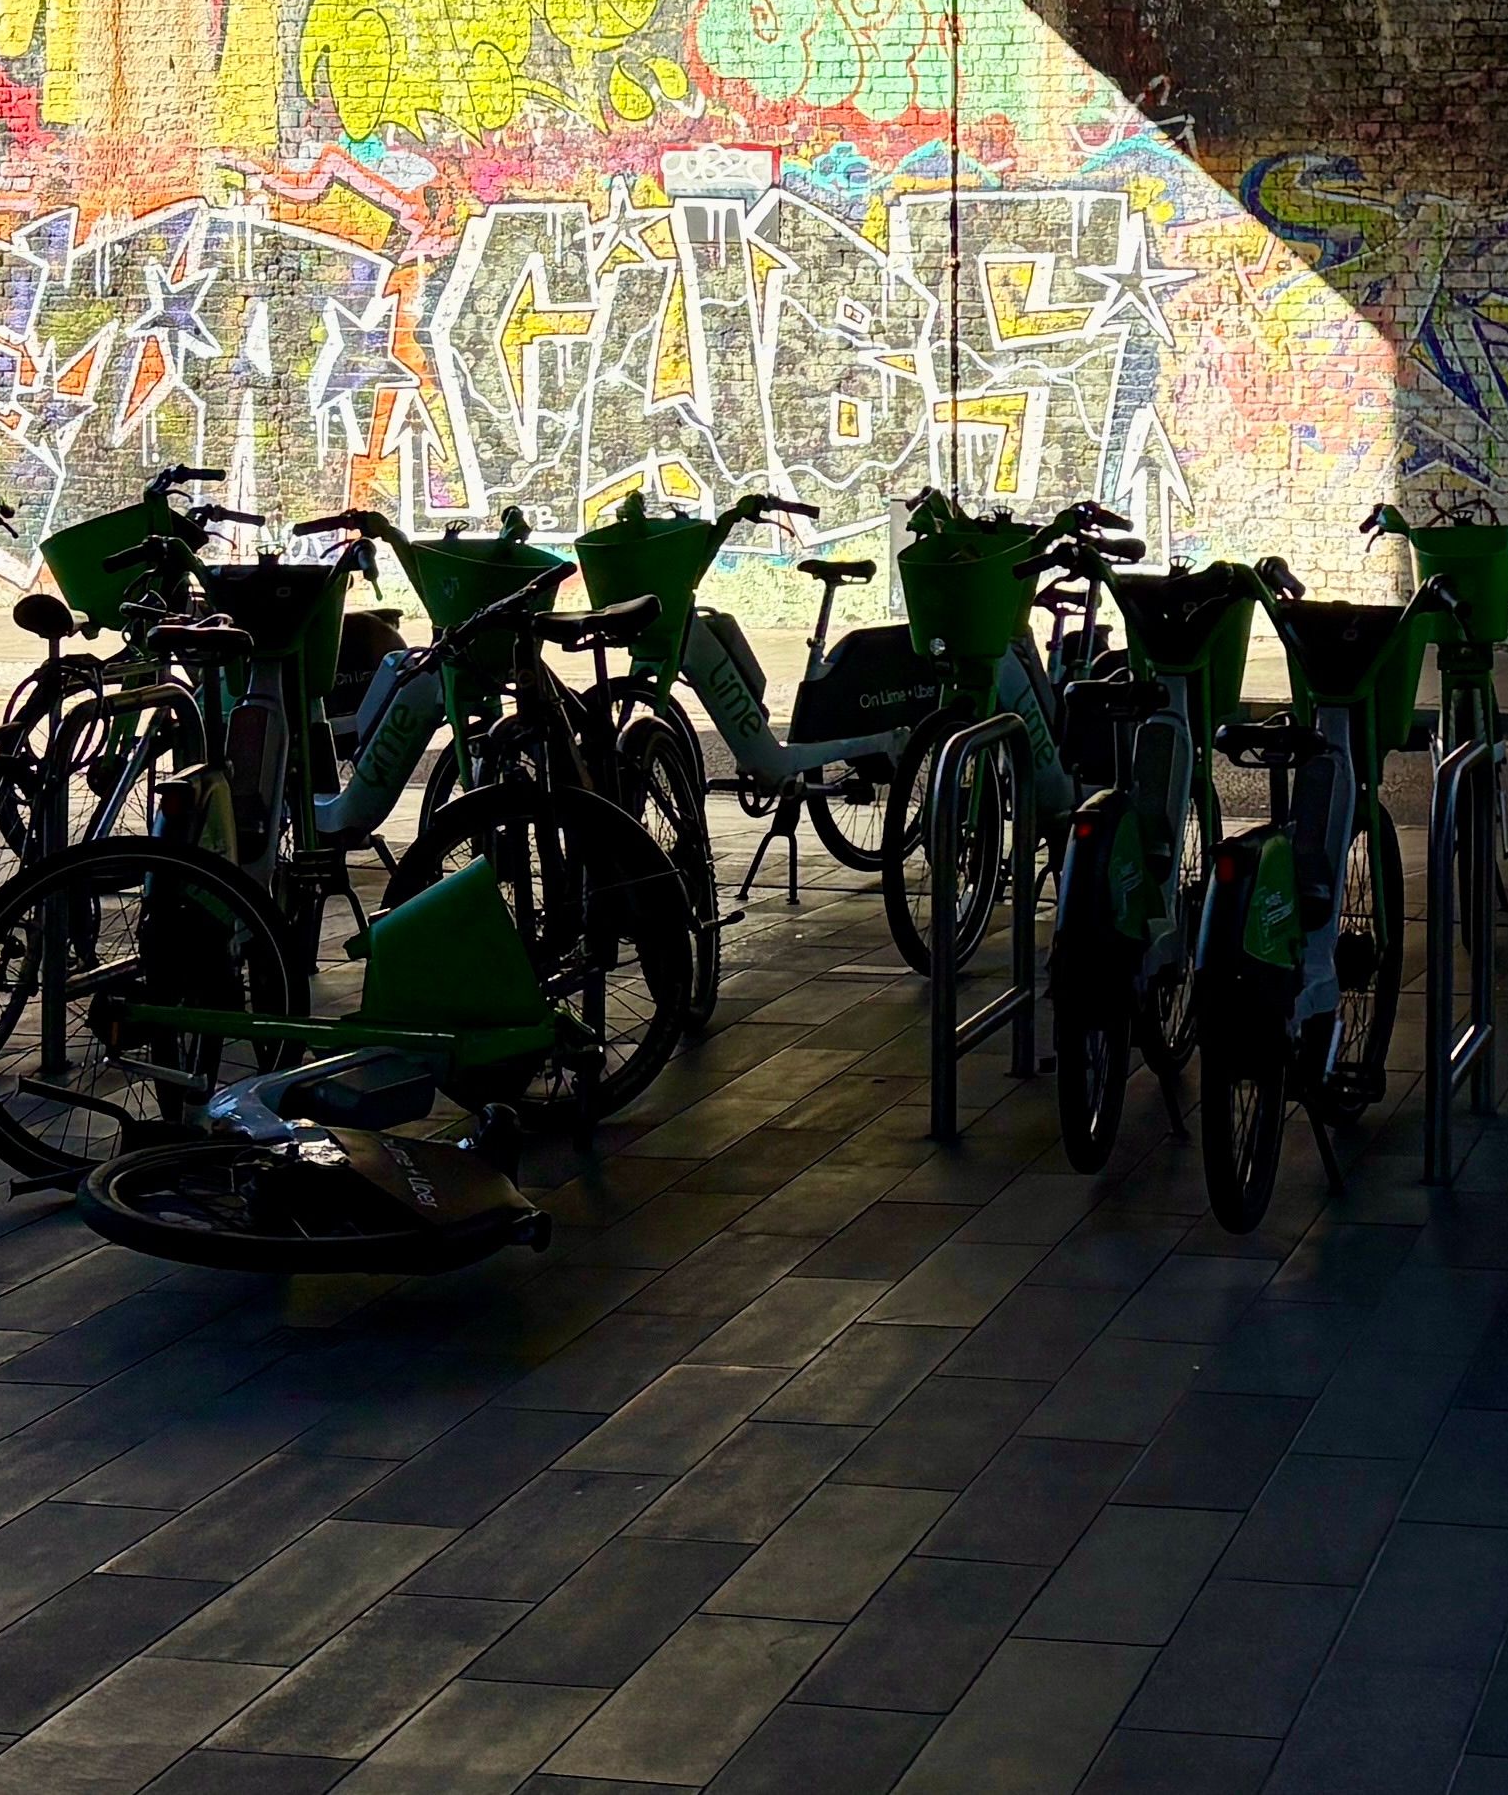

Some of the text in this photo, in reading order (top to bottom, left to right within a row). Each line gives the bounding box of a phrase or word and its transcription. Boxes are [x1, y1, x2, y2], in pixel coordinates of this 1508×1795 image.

[708, 656, 762, 738] Lime
[859, 693, 879, 709] On
[357, 704, 418, 787] Lime
